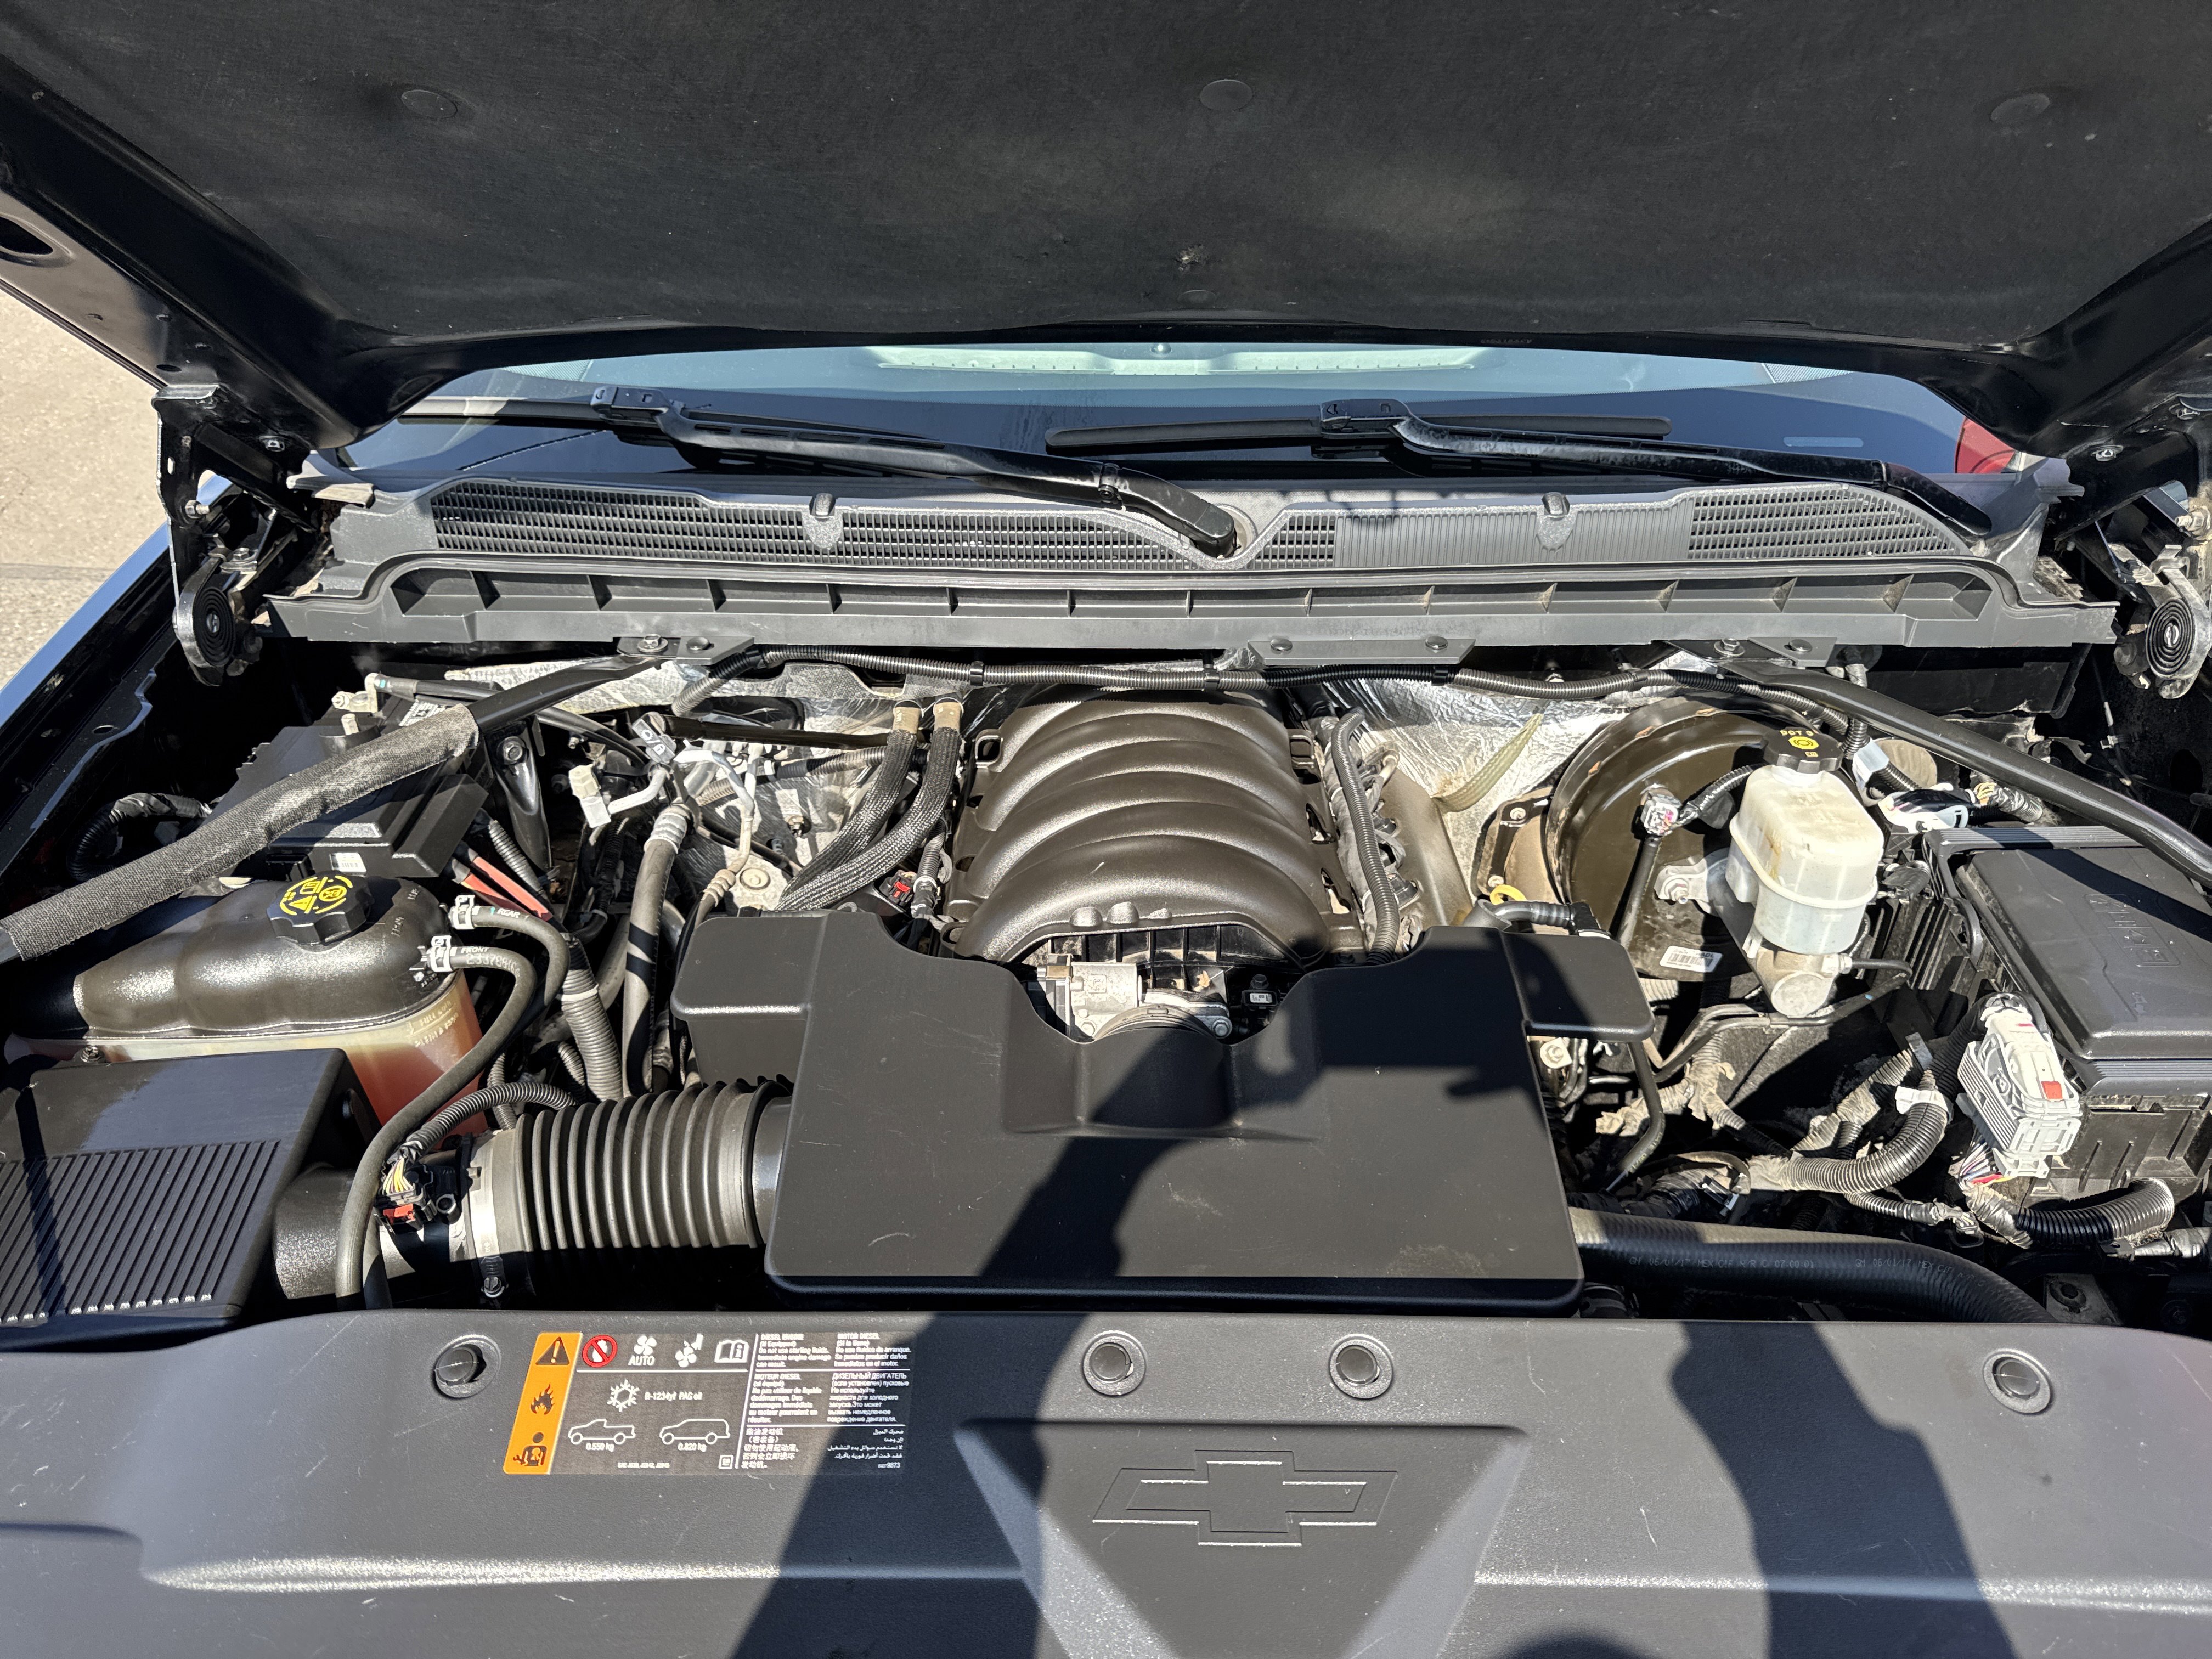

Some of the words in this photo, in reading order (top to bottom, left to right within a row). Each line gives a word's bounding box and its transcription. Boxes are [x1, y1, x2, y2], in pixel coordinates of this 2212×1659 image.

[497, 909, 520, 918] REAR
[628, 1355, 655, 1366] AUTO
[832, 1372, 871, 1380] ДИЗЕЛЬНЫЙ
[644, 1391, 676, 1401] R-1234yf
[679, 1391, 692, 1400] PAG
[606, 1443, 614, 1452] kg
[698, 1443, 707, 1452] kg
[743, 1452, 795, 1460] 否则会立即损坏
